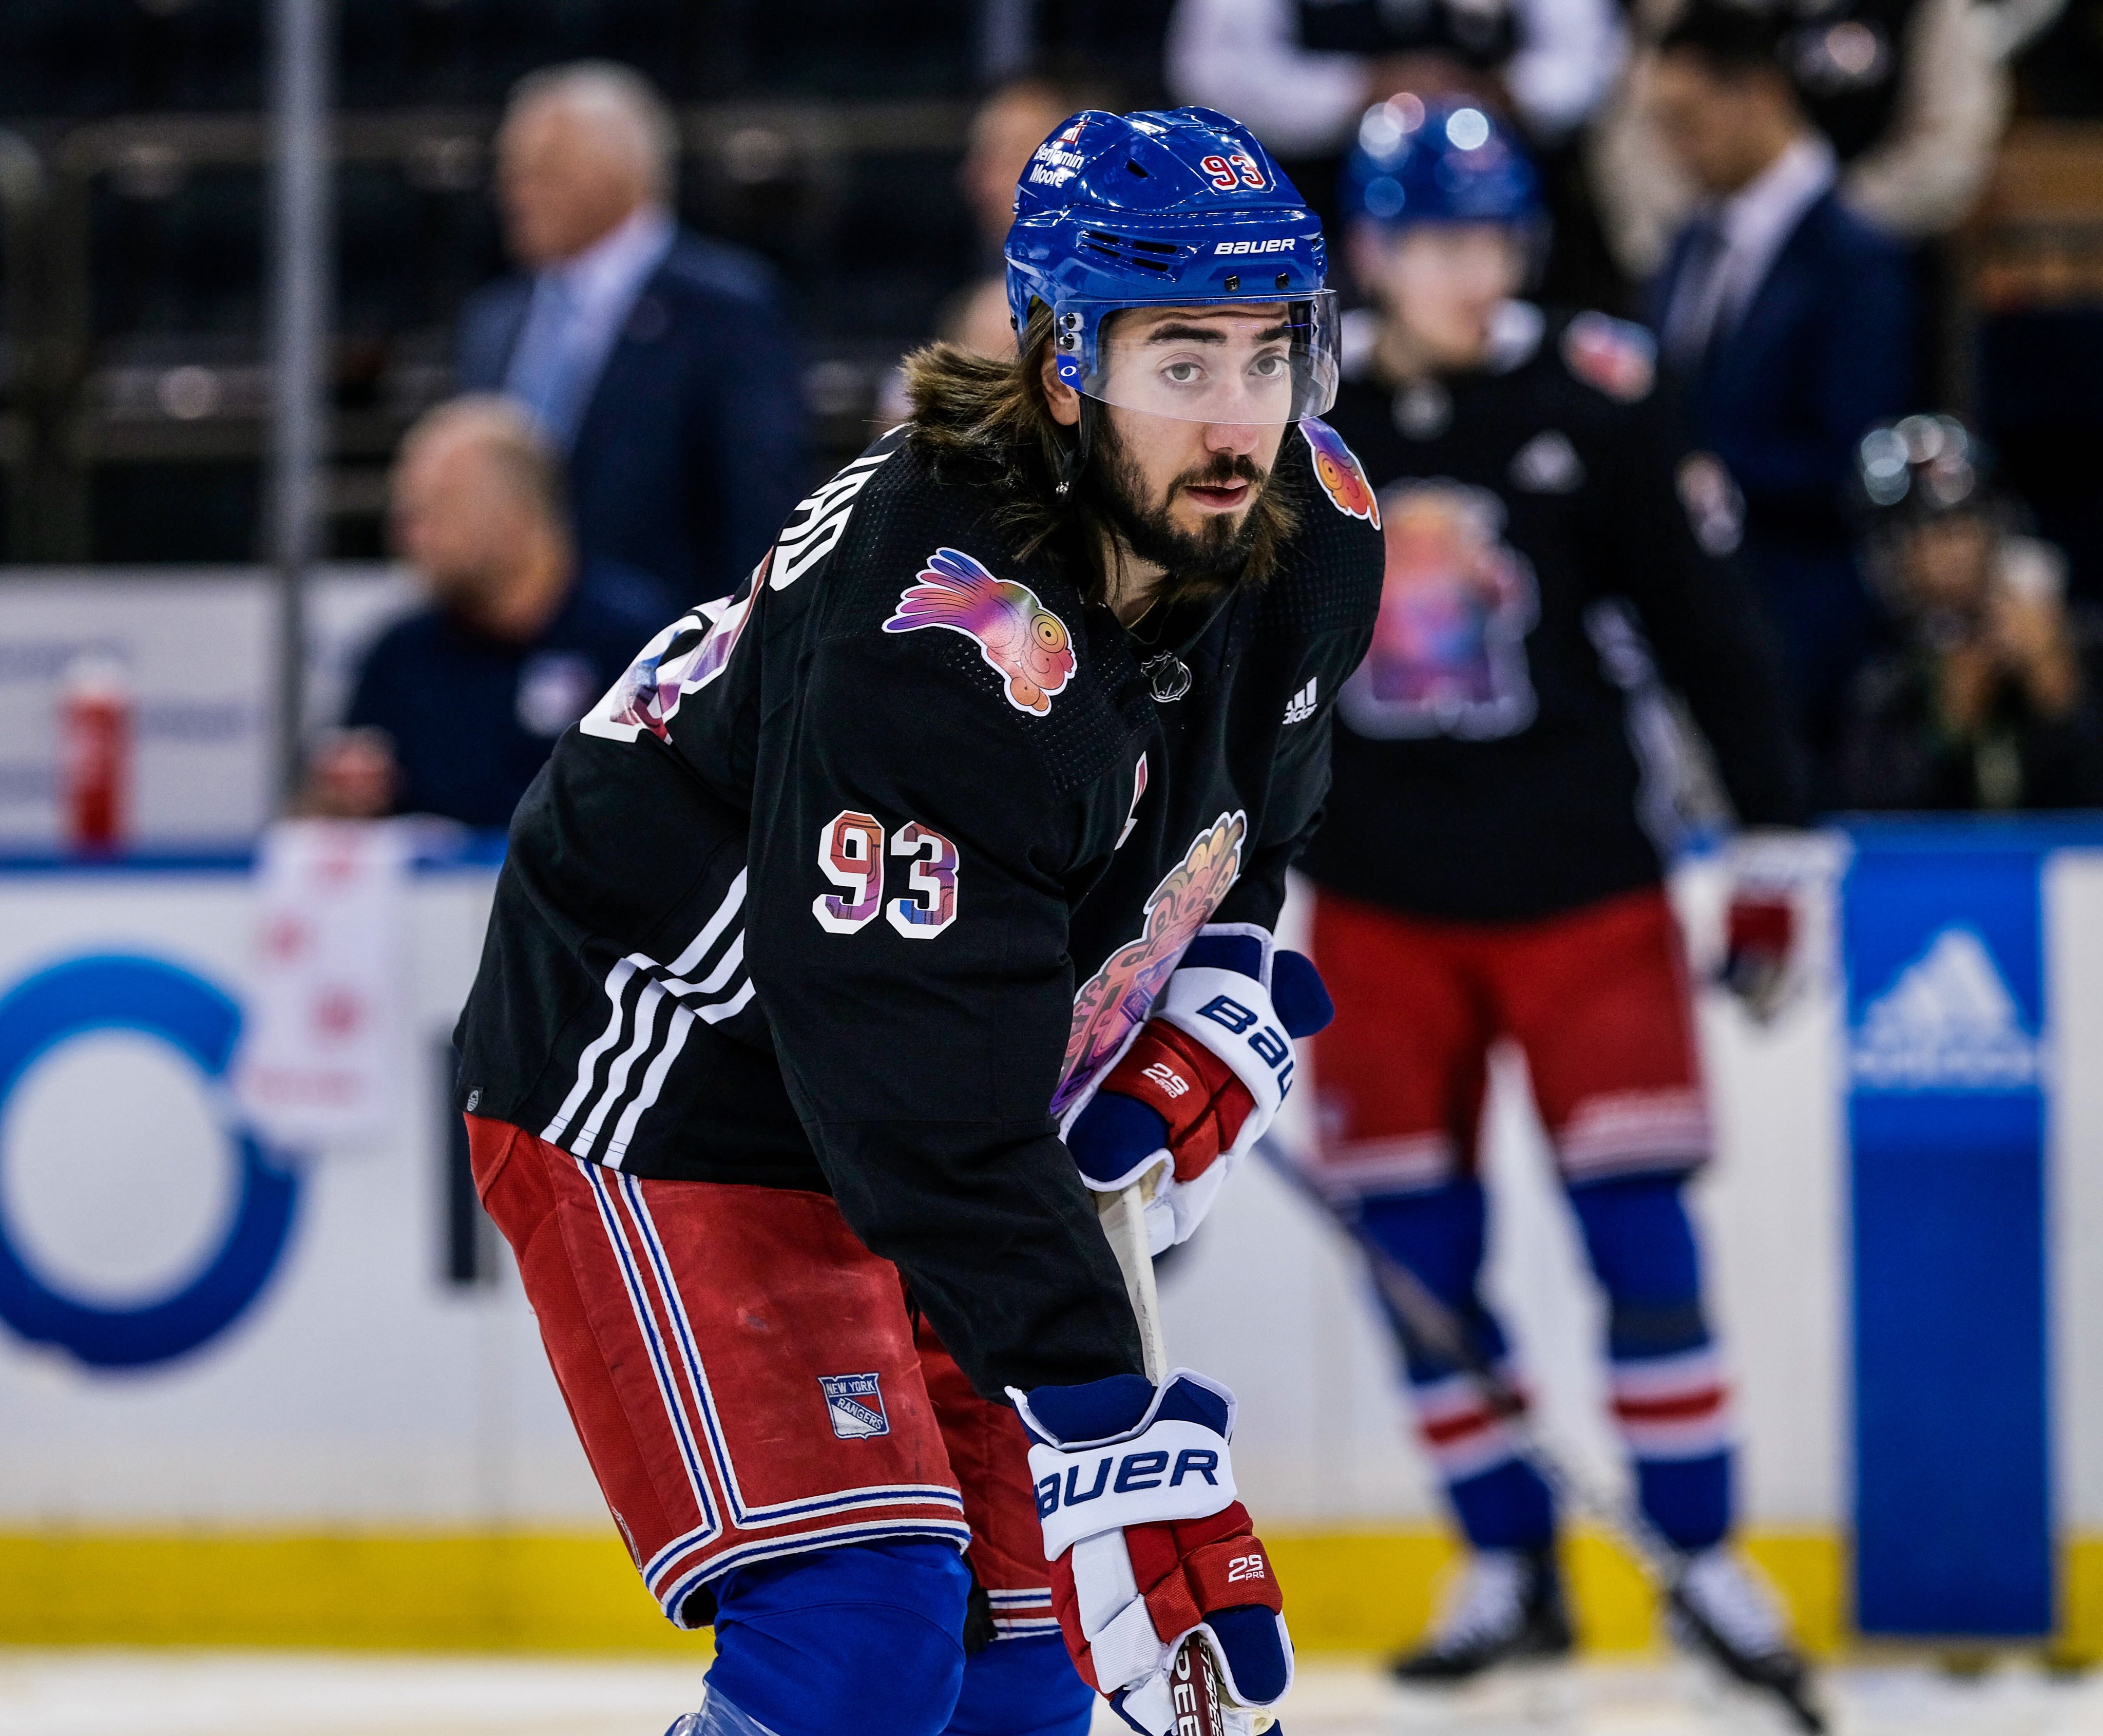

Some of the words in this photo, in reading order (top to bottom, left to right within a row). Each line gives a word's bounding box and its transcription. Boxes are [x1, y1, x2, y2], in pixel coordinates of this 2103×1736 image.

[1033, 143, 1085, 169] Benjamin
[1028, 163, 1066, 188] Moore
[1200, 155, 1266, 190] 93
[1214, 238, 1296, 255] BAUER
[812, 810, 959, 939] 93
[826, 1382, 847, 1395] NEW
[848, 1380, 875, 1392] YORK
[837, 1398, 883, 1429] RANGERS
[1033, 1449, 1218, 1524] AUER
[1246, 1571, 1265, 1580] PRO
